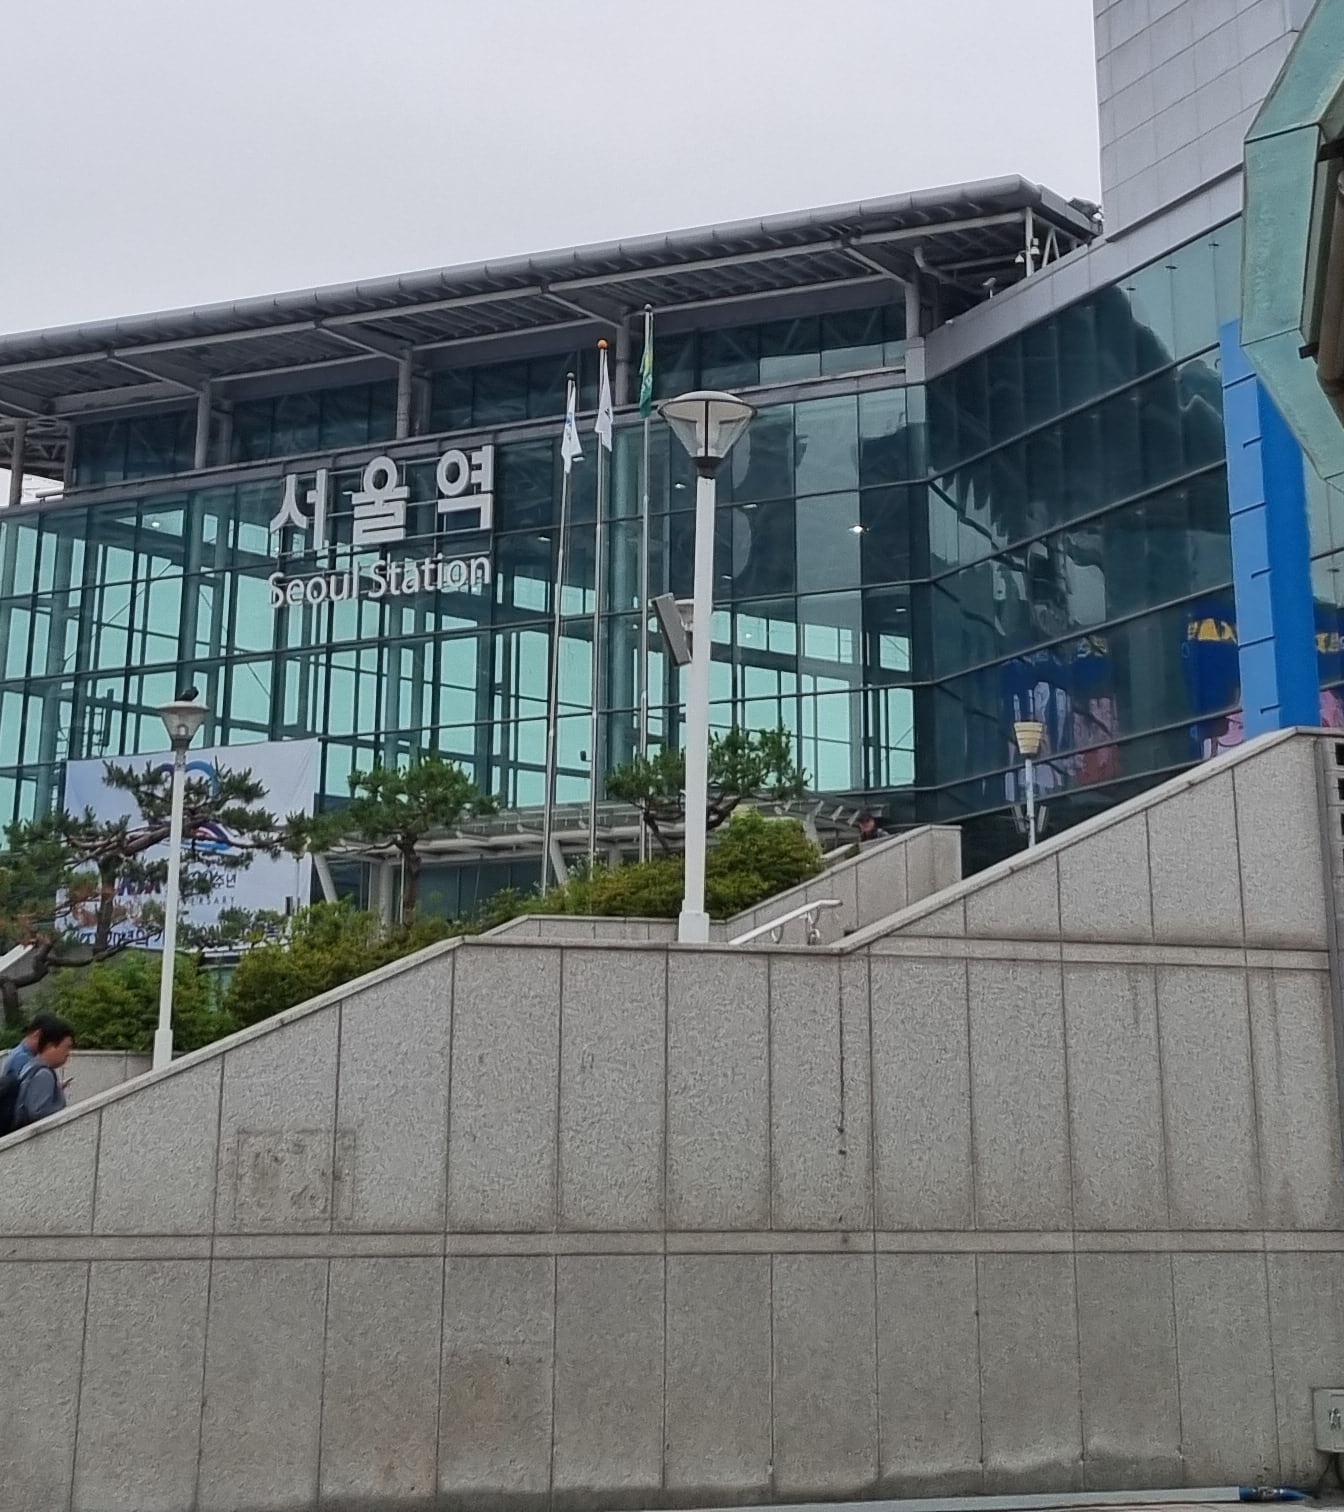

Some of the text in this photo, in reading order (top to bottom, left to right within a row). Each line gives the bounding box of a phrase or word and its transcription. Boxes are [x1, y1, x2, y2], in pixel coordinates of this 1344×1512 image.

[269, 444, 495, 552] 서울역
[268, 552, 491, 609] Seoul Station
